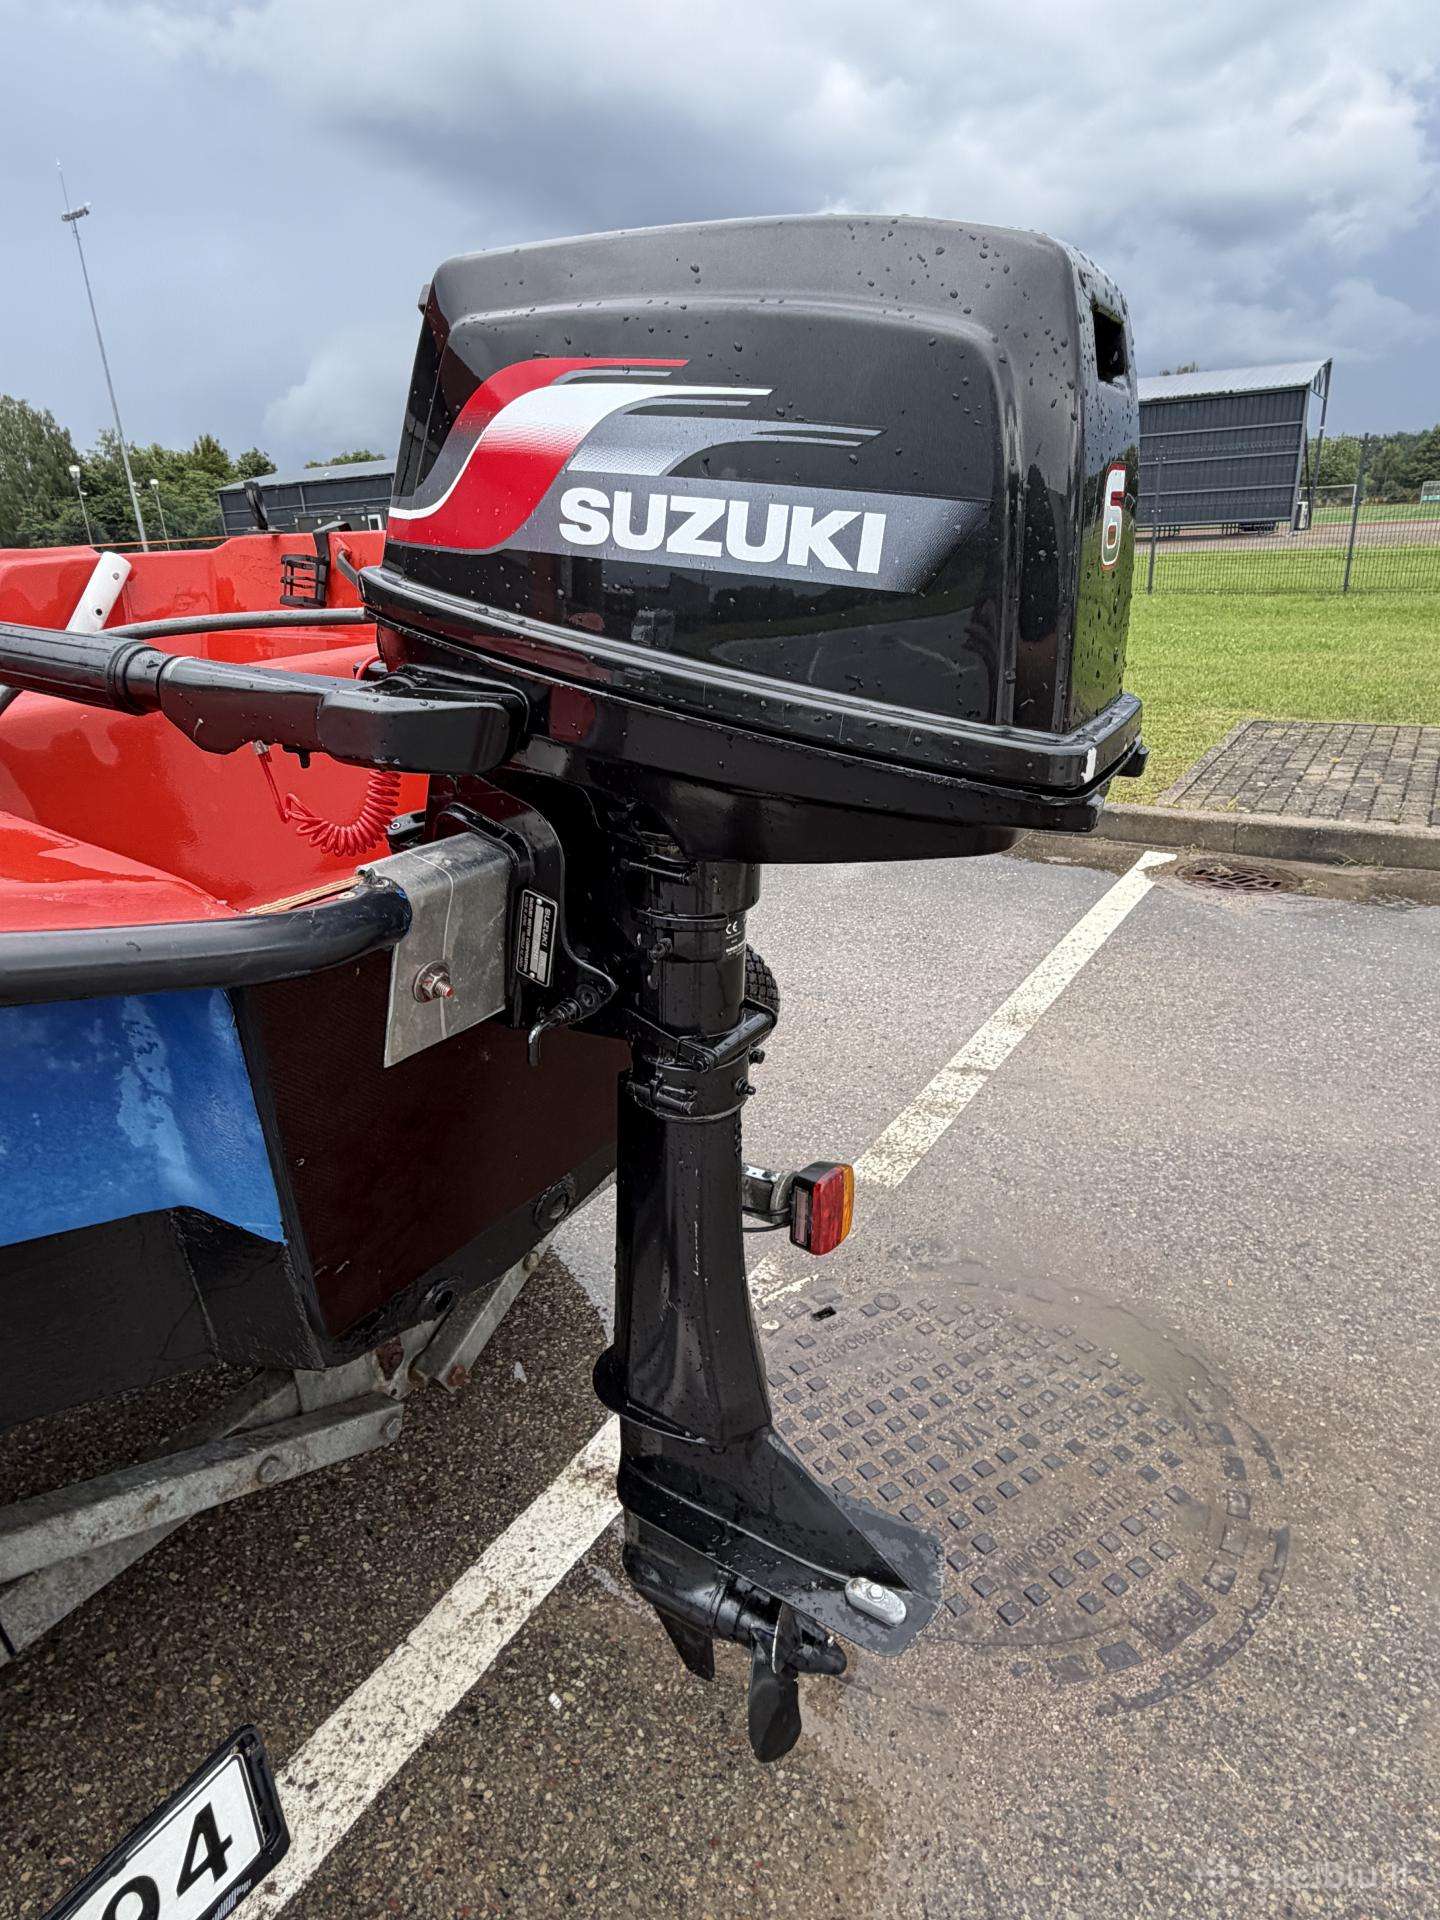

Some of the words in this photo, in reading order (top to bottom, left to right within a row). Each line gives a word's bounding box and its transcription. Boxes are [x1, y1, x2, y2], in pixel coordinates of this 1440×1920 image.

[558, 487, 887, 575] SUZUKI
[1101, 464, 1126, 571] 6
[541, 907, 551, 947] SUZUKI
[725, 920, 738, 935] CE
